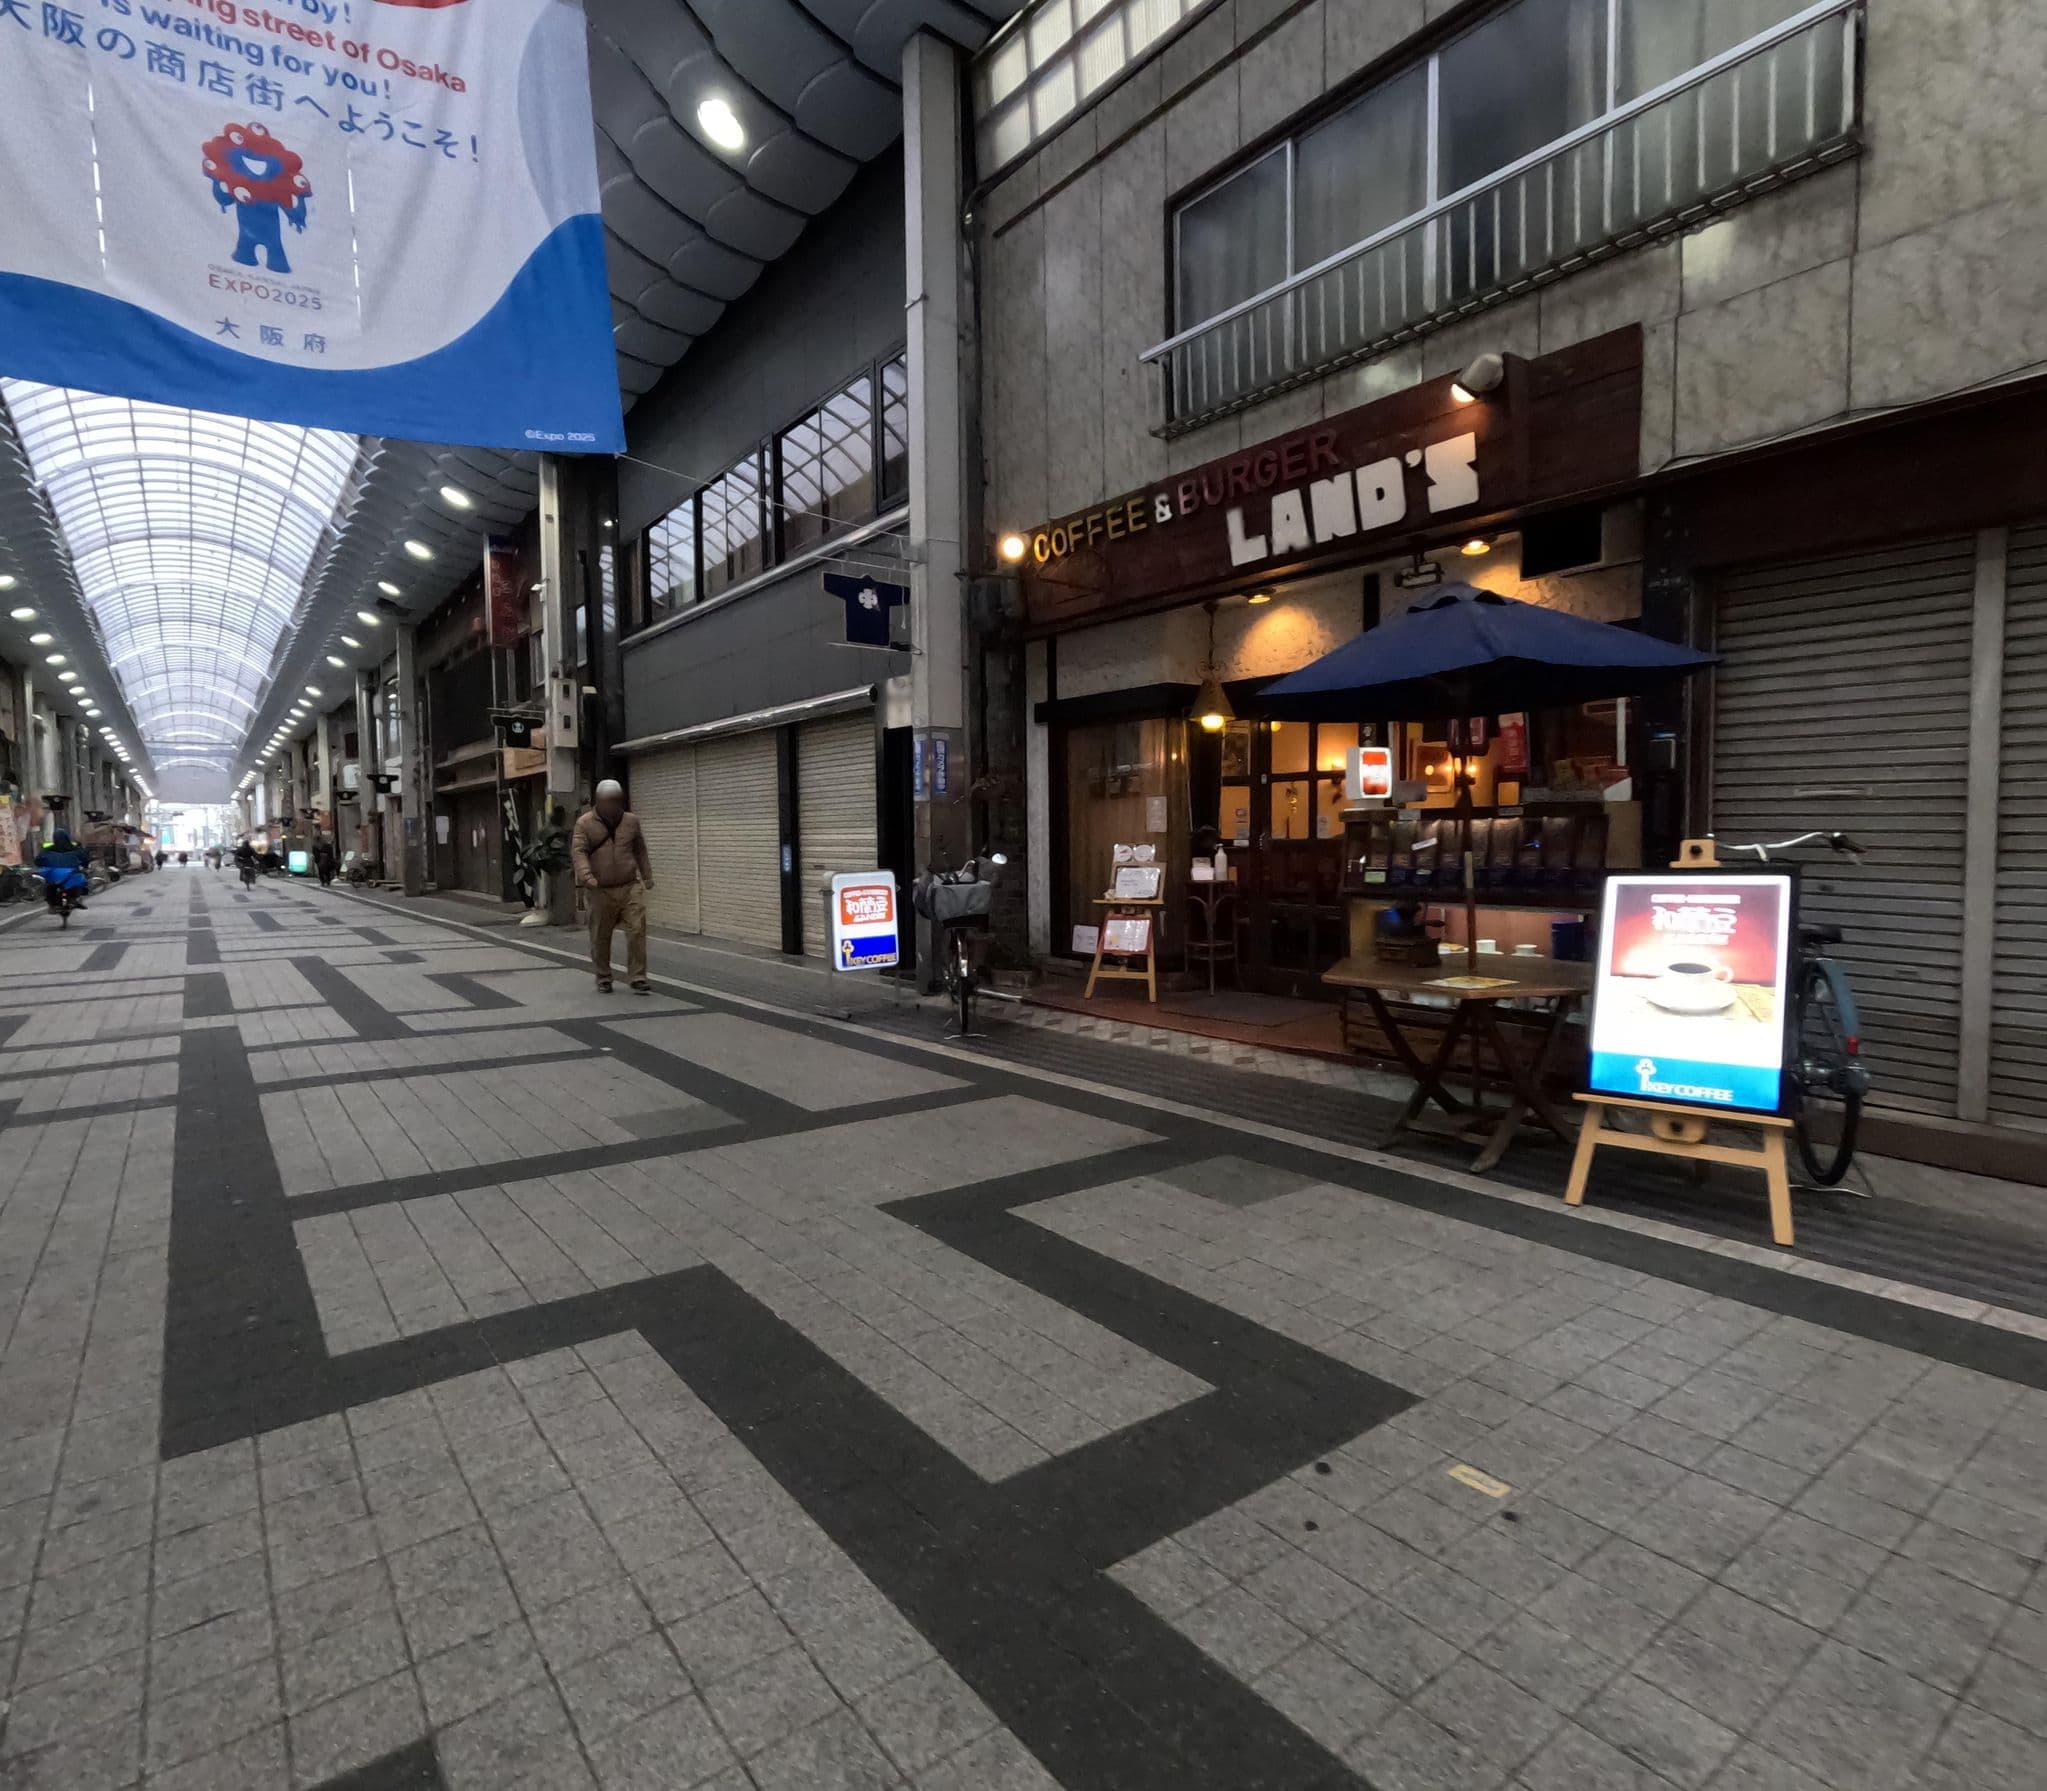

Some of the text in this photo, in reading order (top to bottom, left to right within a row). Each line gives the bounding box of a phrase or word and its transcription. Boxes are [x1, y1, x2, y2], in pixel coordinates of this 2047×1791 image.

[140, 5, 264, 67] waiting
[271, 44, 315, 75] for
[322, 64, 391, 99] you!
[243, 8, 336, 51] street
[342, 39, 370, 63] of
[377, 48, 466, 93] Osaka
[208, 273, 322, 310] EXPO2025
[566, 432, 596, 442] 2025
[1033, 427, 1339, 563] COFFEE & BURGER
[1226, 431, 1480, 567] LAND'S
